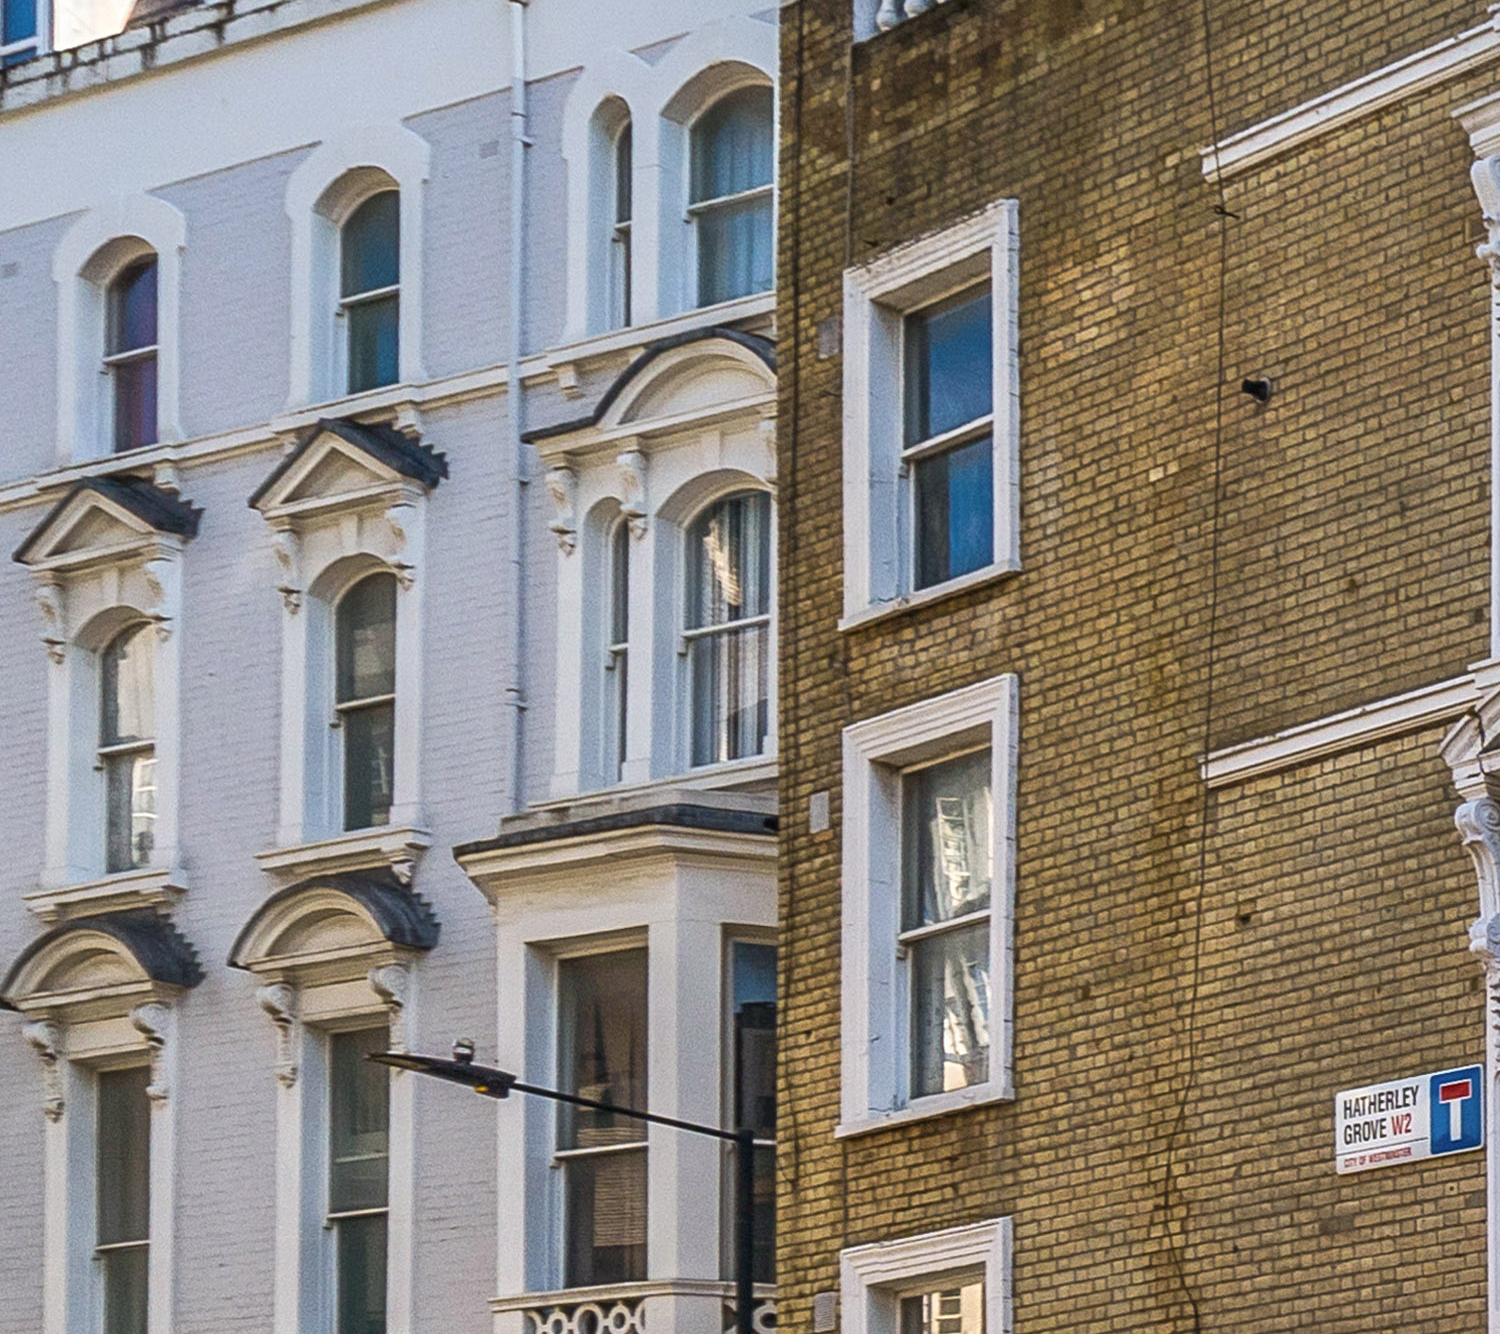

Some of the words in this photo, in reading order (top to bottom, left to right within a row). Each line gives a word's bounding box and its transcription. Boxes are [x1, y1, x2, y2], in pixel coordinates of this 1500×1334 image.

[1343, 1084, 1420, 1120] HATHERLEY
[1344, 1117, 1387, 1145] GROVE
[1391, 1113, 1412, 1136] W2
